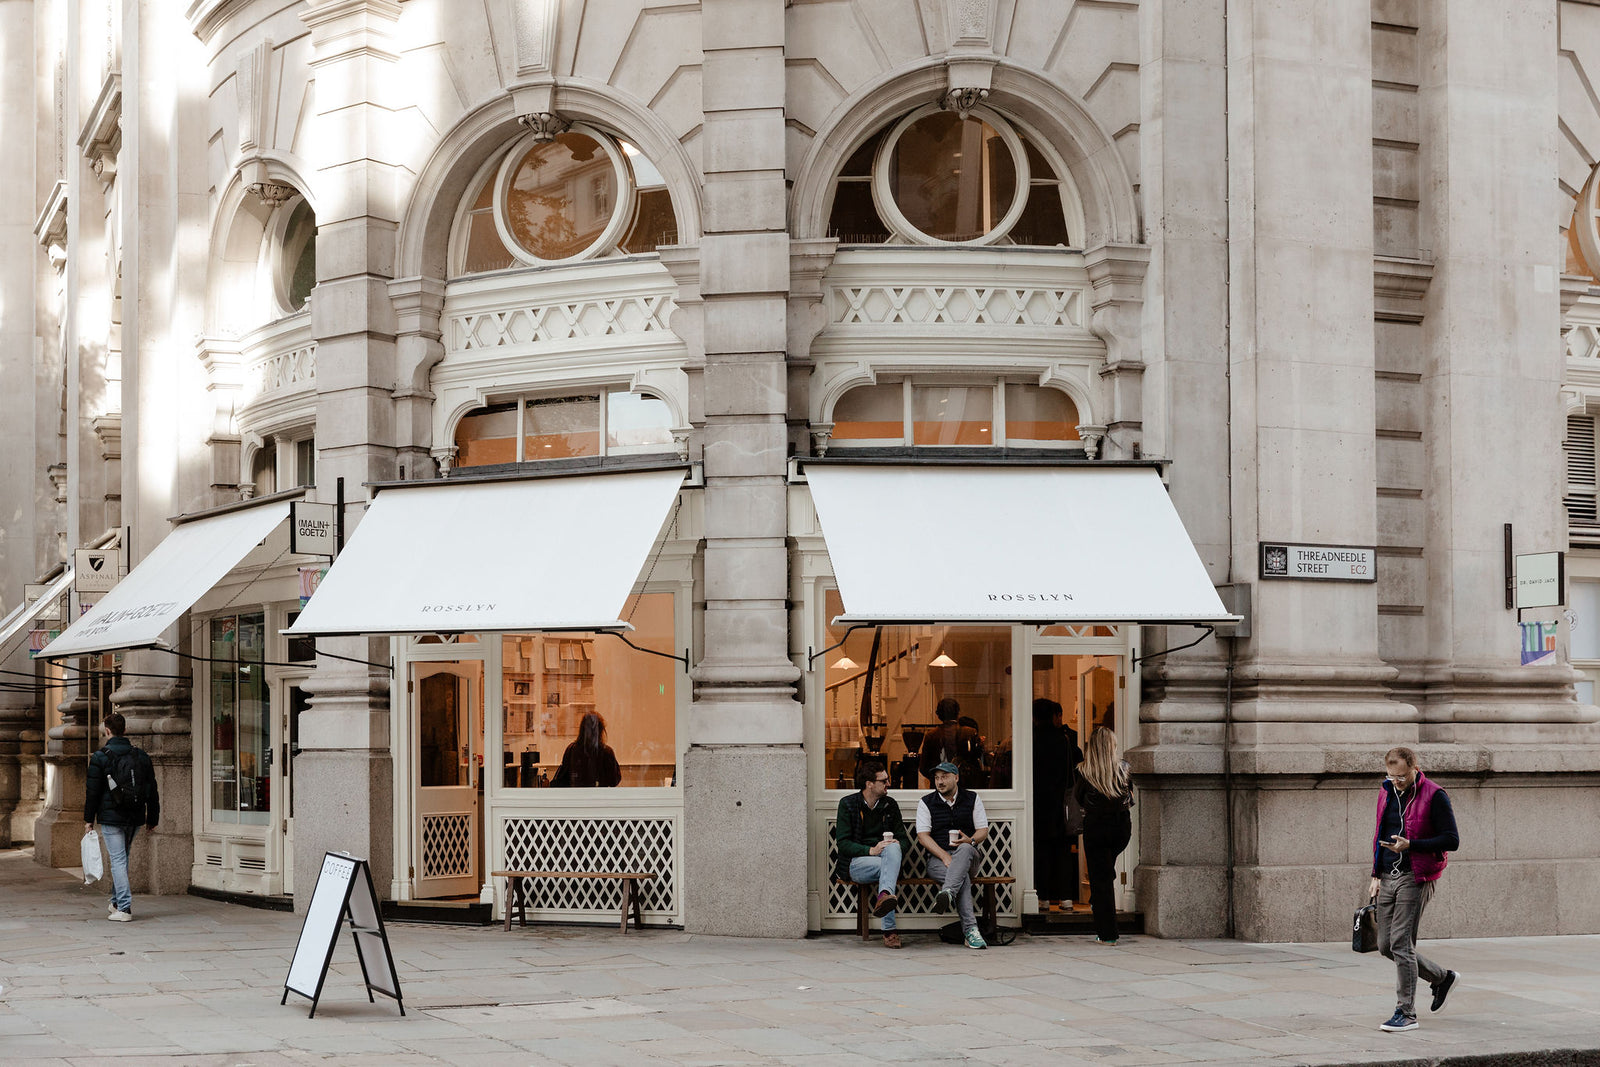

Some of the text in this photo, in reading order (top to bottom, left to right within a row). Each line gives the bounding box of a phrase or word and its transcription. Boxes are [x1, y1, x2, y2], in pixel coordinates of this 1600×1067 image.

[298, 520, 330, 528] (MALIN+
[300, 528, 328, 537] GOETZ)
[1297, 550, 1366, 562] THREADNEEDLE
[1297, 562, 1329, 574] STREET
[1350, 564, 1367, 575] EC2
[988, 594, 1073, 602] ROSSLYN
[422, 604, 496, 612] ROSSLYN
[324, 861, 352, 880] COFFEE
